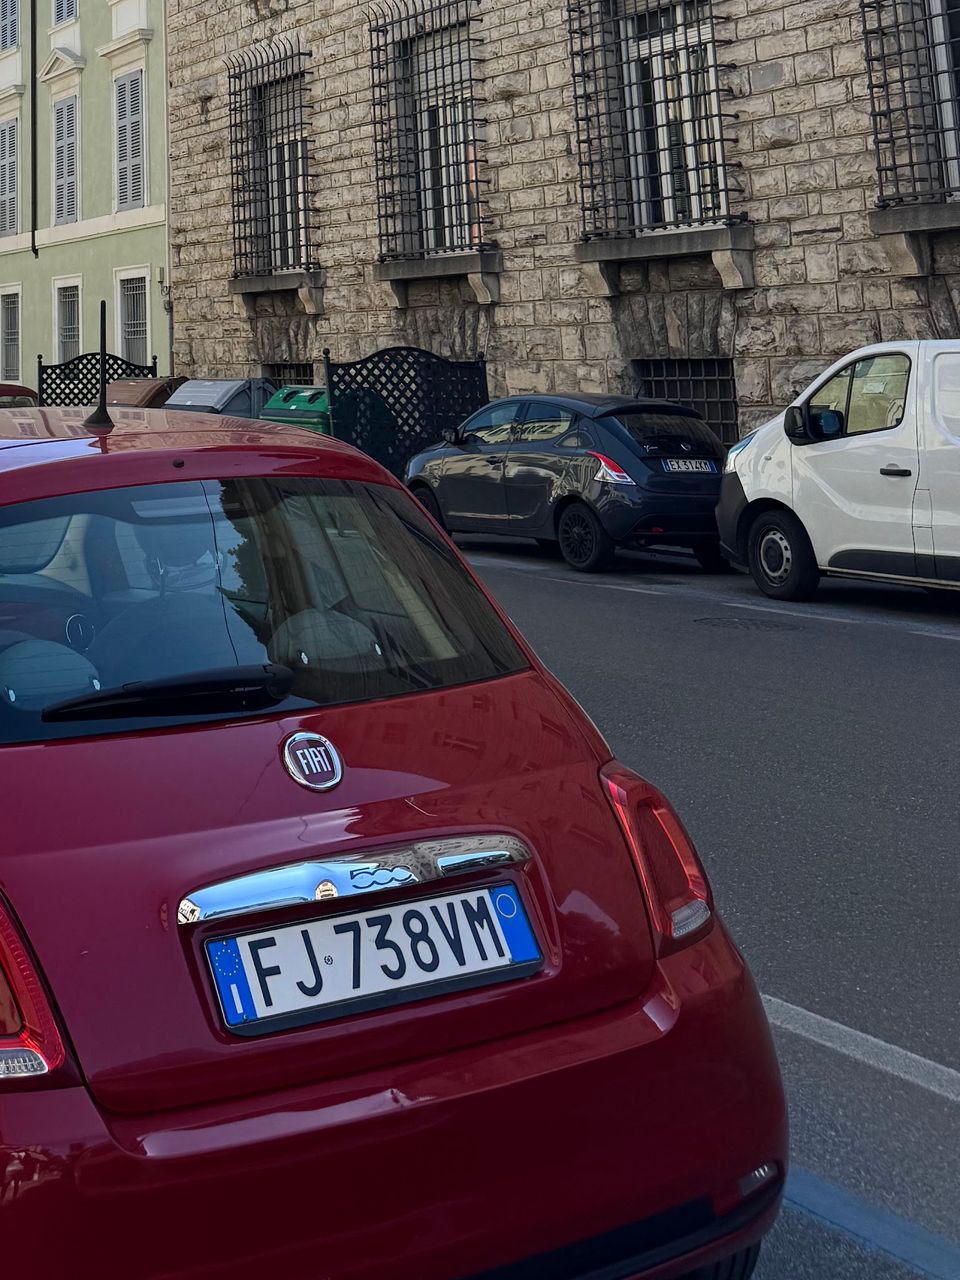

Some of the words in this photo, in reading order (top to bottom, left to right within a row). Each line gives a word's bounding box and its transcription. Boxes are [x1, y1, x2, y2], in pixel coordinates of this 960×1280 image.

[295, 747, 331, 775] FIAT
[350, 864, 413, 890] 500
[248, 928, 323, 1007] FJ
[333, 896, 505, 990] 738VM
